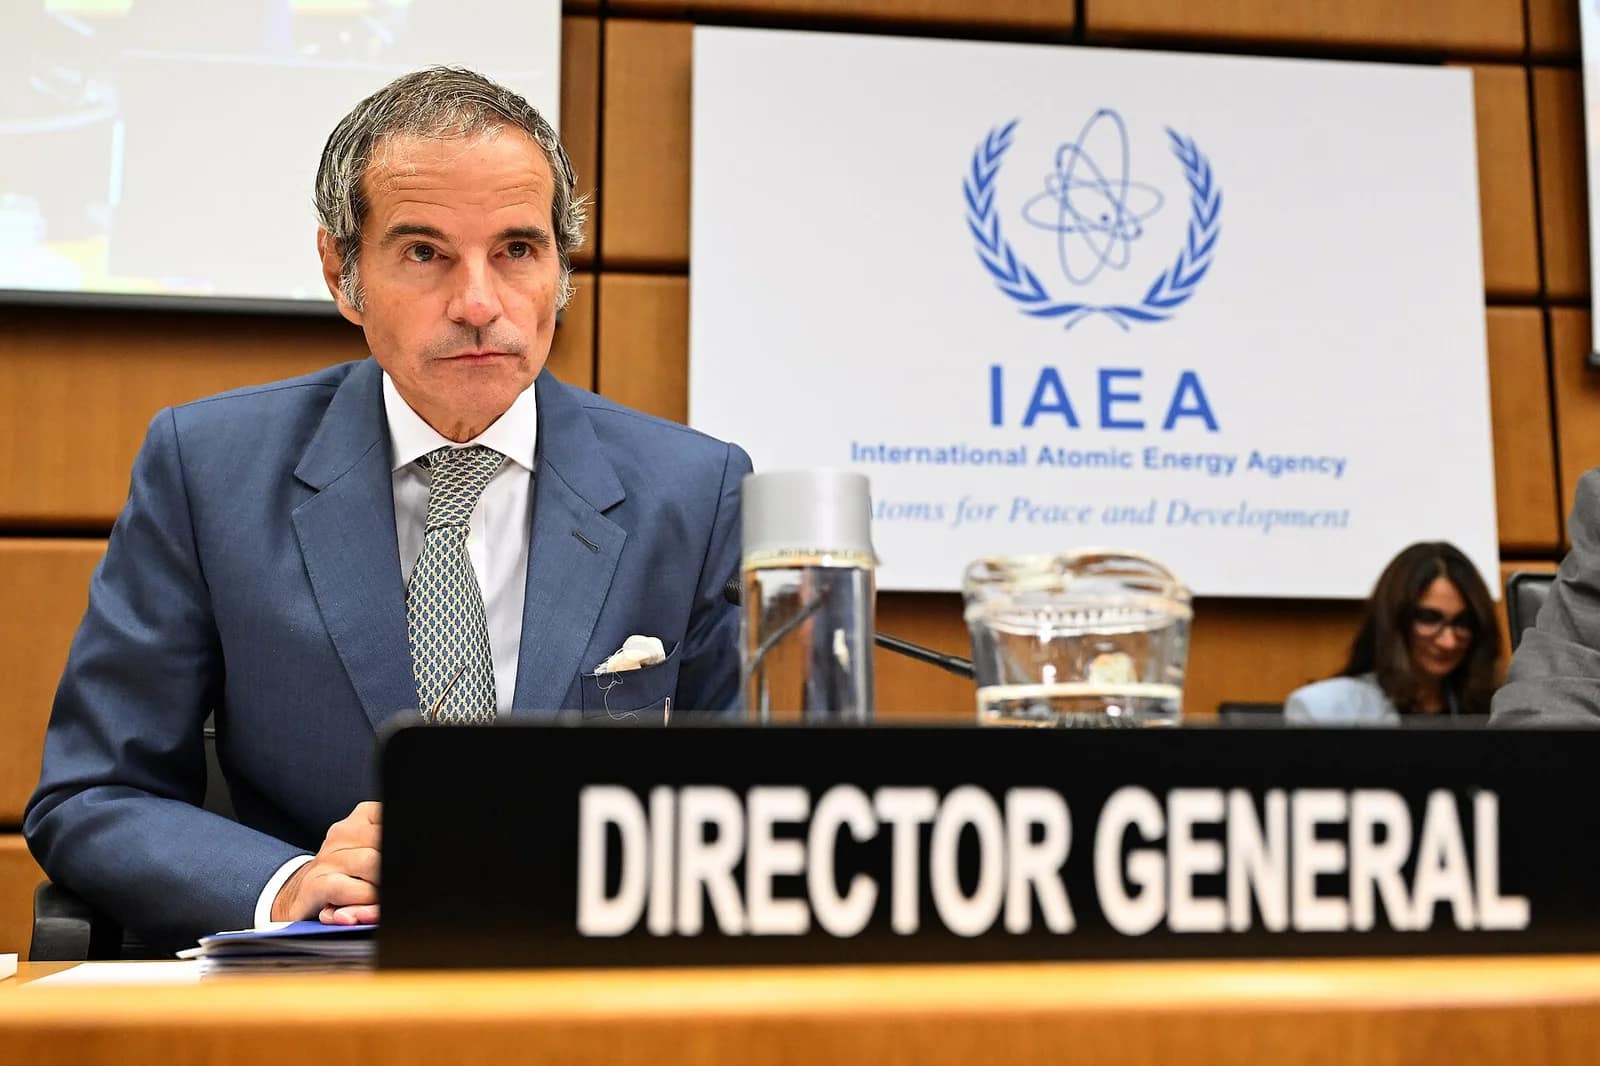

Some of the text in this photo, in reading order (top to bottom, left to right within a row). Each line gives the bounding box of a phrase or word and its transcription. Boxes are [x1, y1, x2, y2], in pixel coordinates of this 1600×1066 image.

[989, 364, 1221, 433] IAEA
[850, 441, 1347, 479] International Atomic Energy Agency
[874, 496, 1350, 533] toms for Peace and Development
[576, 784, 1532, 938] DIRECTOR GENERAL
